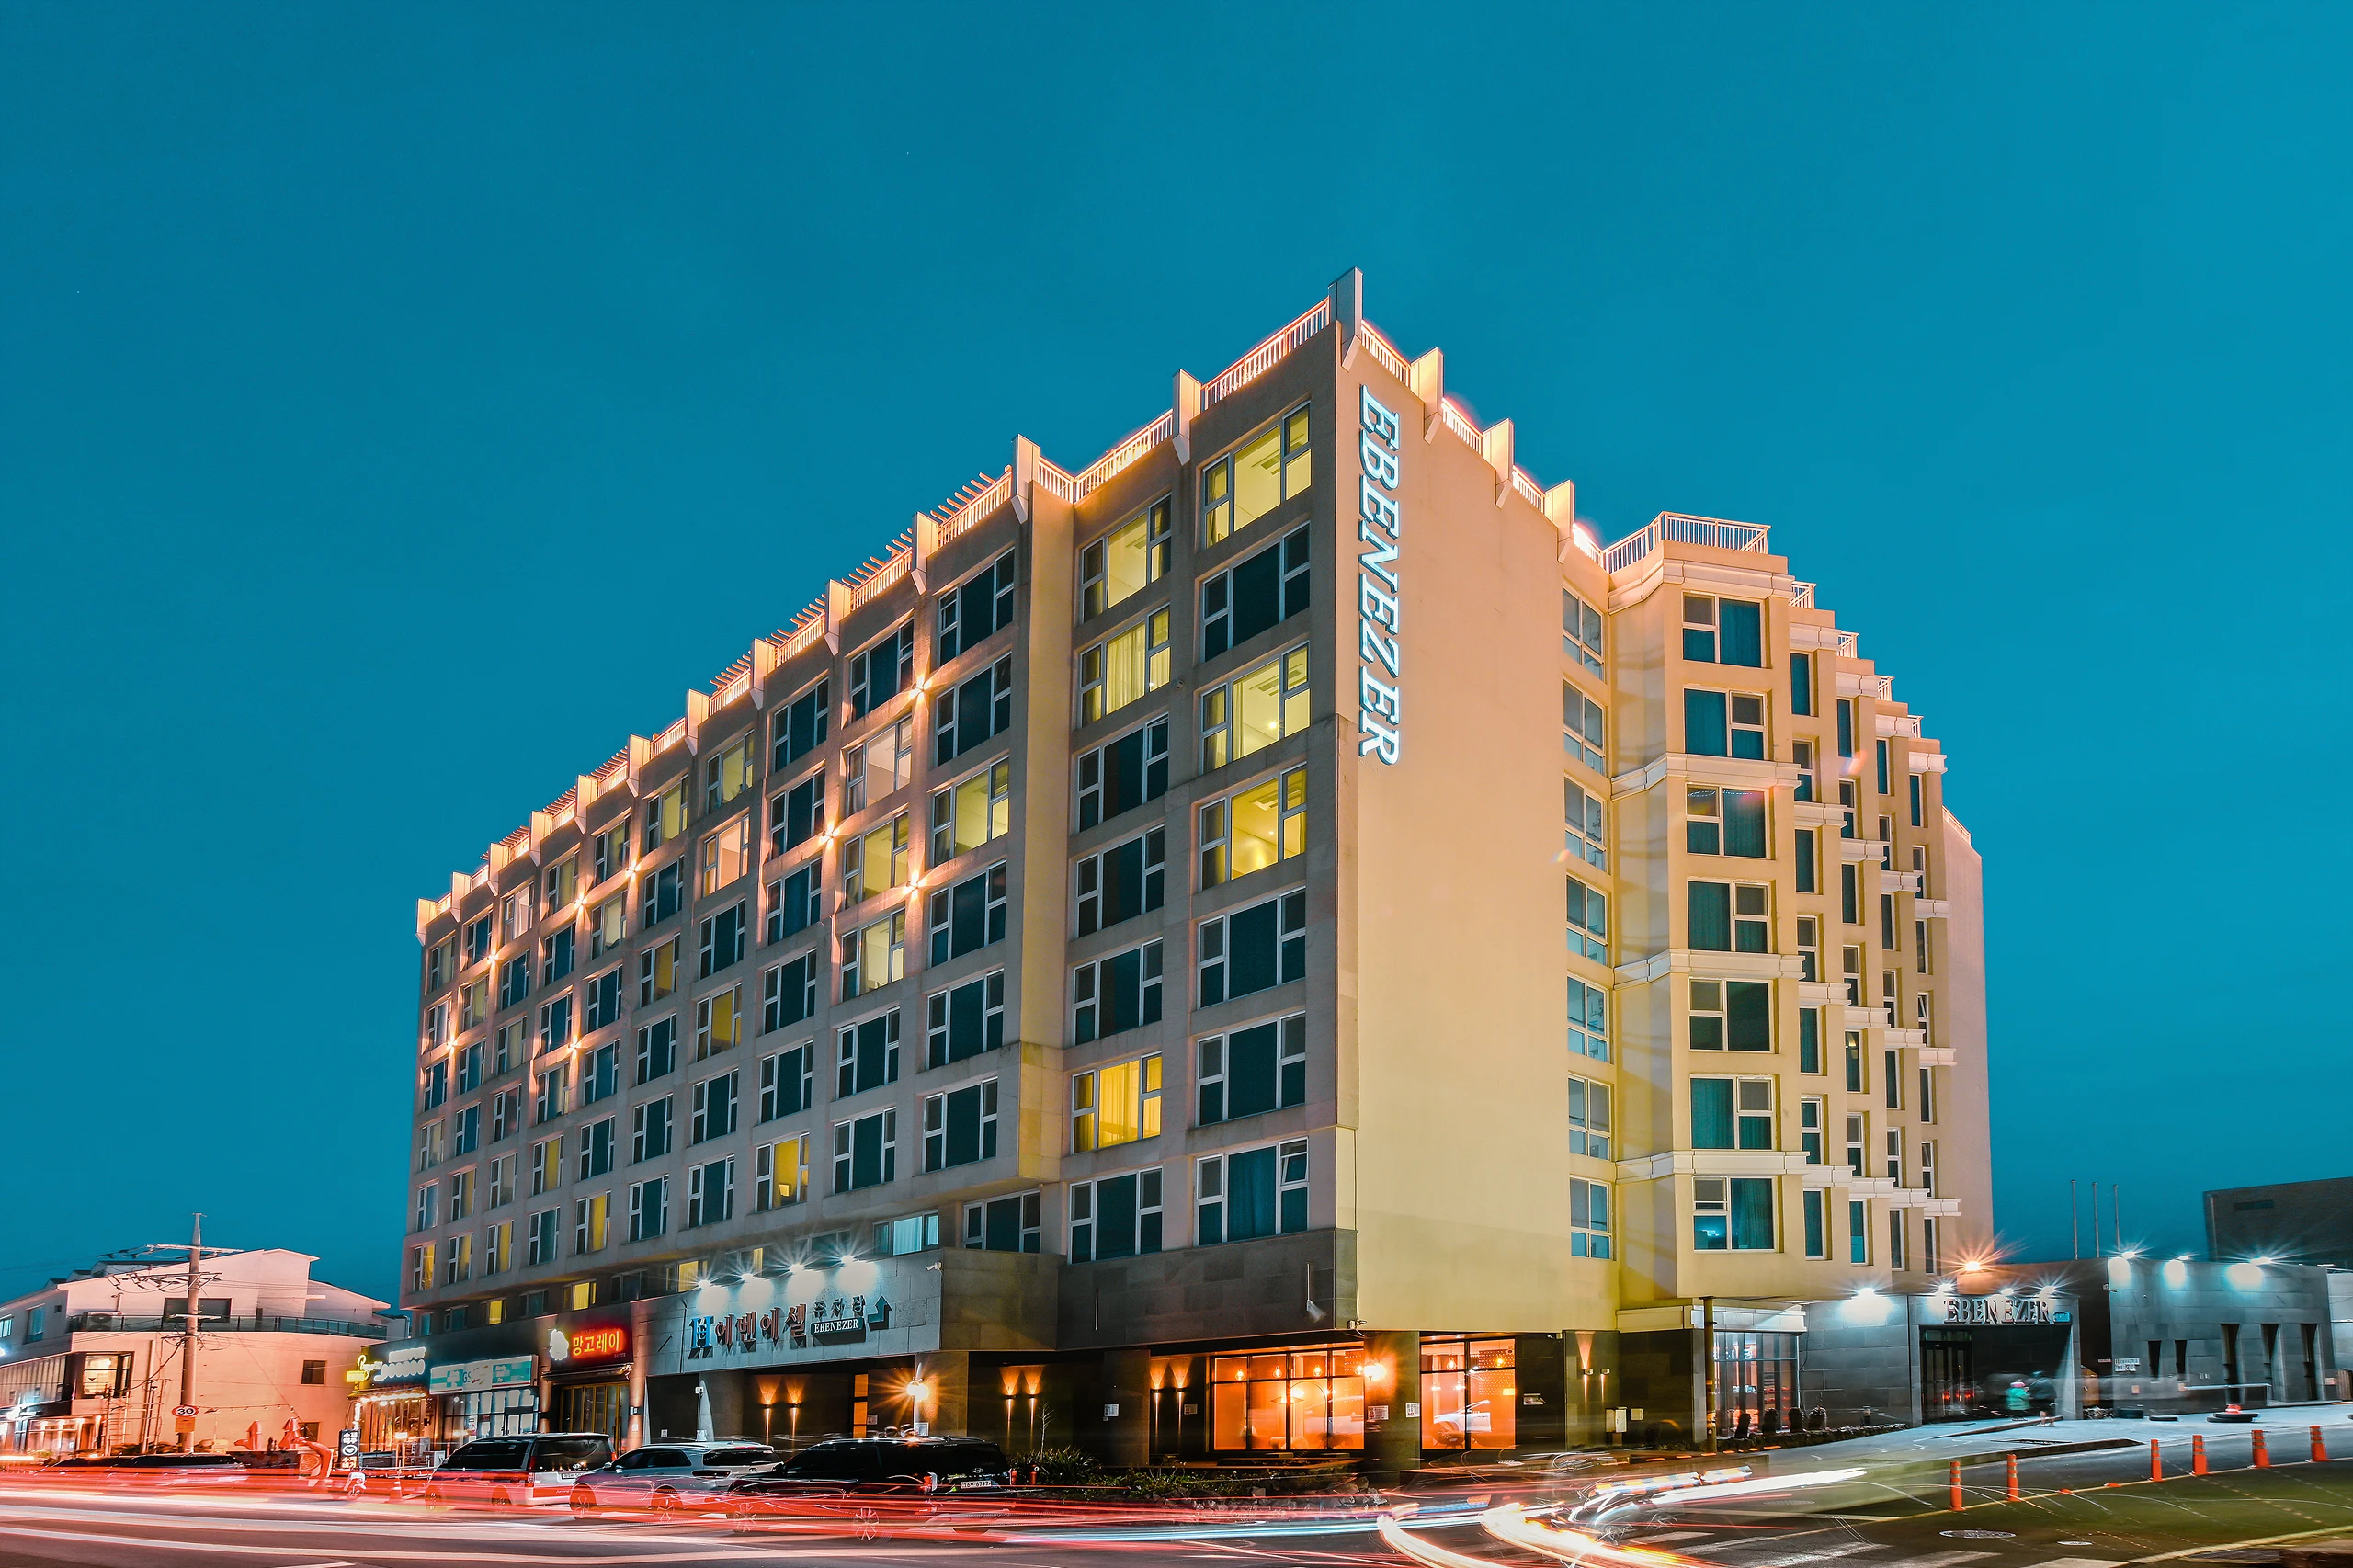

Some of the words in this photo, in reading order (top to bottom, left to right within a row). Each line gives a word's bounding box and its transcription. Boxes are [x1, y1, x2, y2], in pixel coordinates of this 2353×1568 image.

[1359, 383, 1401, 767] EBENEZER
[1944, 1298, 2052, 1324] EBENEZER
[715, 1304, 807, 1346] 에벤에셀
[813, 1318, 859, 1334] EBENEZER
[573, 1330, 620, 1356] 망고레이
